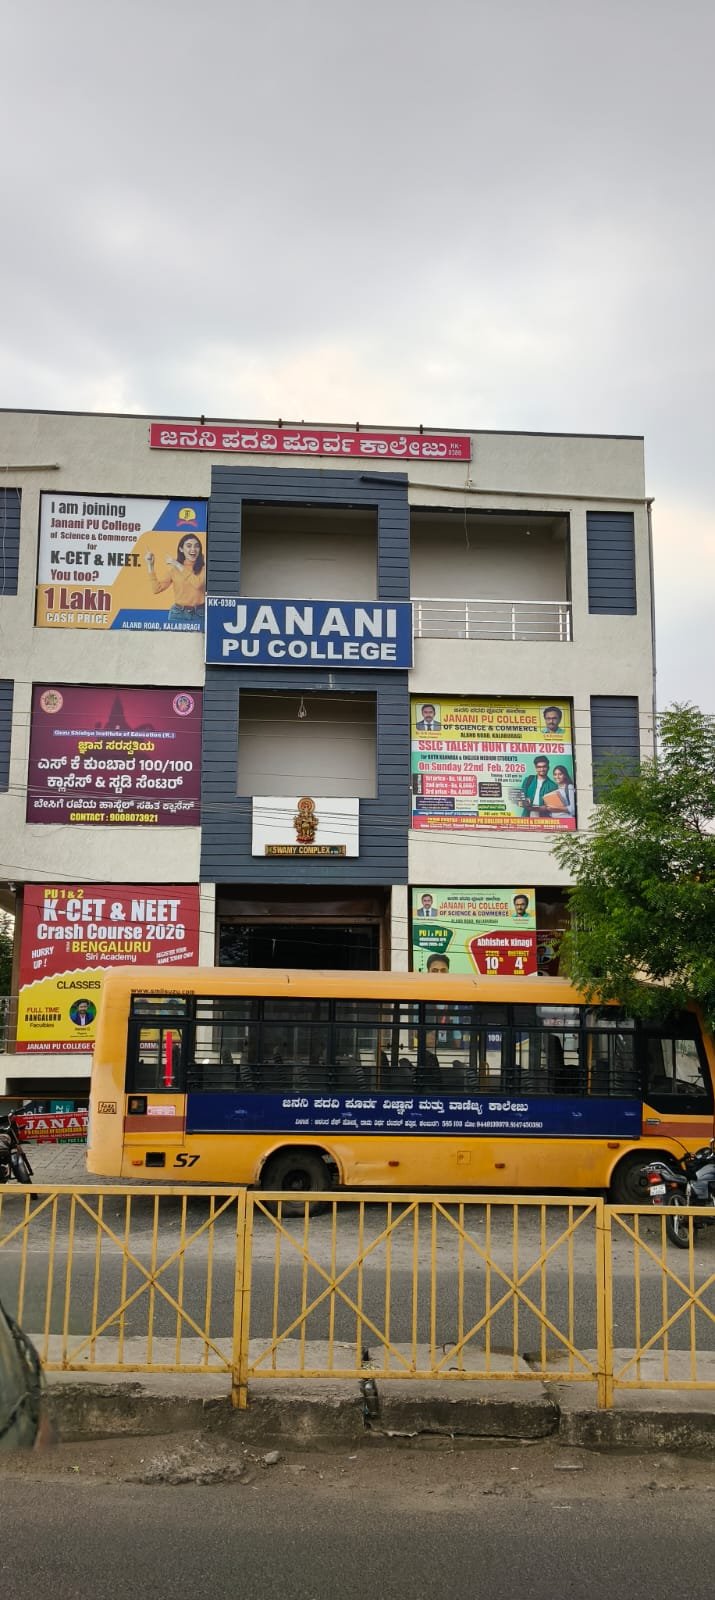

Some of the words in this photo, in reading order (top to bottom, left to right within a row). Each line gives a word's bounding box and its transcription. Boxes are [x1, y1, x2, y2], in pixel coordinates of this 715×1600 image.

[160, 428, 216, 447] ಜನನಿ
[222, 430, 277, 449] ಪದವಿ
[283, 432, 354, 452] ಪೂರ್ವ
[360, 436, 447, 456] ಕಾಲೇಜು
[51, 502, 55, 513] I
[58, 502, 78, 514] am
[82, 502, 126, 517] joining
[50, 518, 84, 529] Janani
[86, 520, 99, 530] PU
[102, 520, 141, 532] College
[60, 532, 90, 540] Science
[98, 533, 138, 542] Commerce
[51, 550, 91, 565] K-CET
[94, 554, 104, 566] &
[108, 553, 141, 567] NEET.
[51, 569, 71, 580] You
[74, 570, 99, 581] too?
[44, 588, 54, 608] 1
[60, 588, 111, 611] Lakh
[47, 612, 74, 623] CASH
[78, 613, 108, 624] PRICE
[223, 605, 396, 638] JANANI
[143, 622, 162, 630] ROAD,
[163, 623, 200, 631] KALABURAGI
[222, 639, 260, 657] PU
[267, 640, 396, 661] COLLEGE
[444, 715, 478, 723] JANANI
[497, 716, 537, 724] COLLEGE
[78, 740, 103, 754] ಜ್ಞಾನ
[106, 740, 155, 754] ಸರಸ್ವತಿಯ
[419, 740, 443, 751] SSLC
[446, 741, 479, 752] TALENT
[483, 742, 508, 752] HUNT
[510, 742, 536, 753] EXAM
[539, 743, 565, 753] 2026
[38, 756, 67, 770] ಎಸ್
[71, 756, 80, 770] ಕೆ
[84, 757, 136, 771] ಕುಂಬಾರ
[139, 760, 192, 772] 100/100
[419, 762, 429, 771] On
[432, 762, 462, 772] Sunday
[464, 763, 483, 771] 22nd
[488, 764, 503, 772] Feb.
[505, 764, 525, 772] 2026
[47, 773, 92, 792] ಕ್ಲಾಸೆಸ್
[95, 776, 105, 788] &
[109, 775, 132, 793] ಸ್ಟಡಿ
[136, 775, 183, 789] ಸೆಂಟರ್
[34, 798, 64, 808] ಬೇಸಿಗೆ
[70, 813, 104, 822] CONTACT
[110, 814, 158, 822] 9008073921
[272, 846, 296, 854] SWAMY
[299, 846, 330, 854] COMPLEX
[44, 889, 57, 898] PU
[61, 890, 65, 898] 1
[68, 890, 75, 898] &
[77, 890, 84, 898] 2
[43, 899, 106, 922] K-CET
[110, 902, 126, 922] &
[131, 900, 180, 922] NEET
[440, 902, 465, 910] JANANI
[467, 902, 477, 910] PU
[478, 902, 508, 910] COLLEGE
[37, 923, 83, 940] Crash
[87, 924, 142, 940] Course
[145, 924, 185, 940] 2026
[72, 941, 151, 953] BENGALURU
[477, 938, 509, 947] Abhishek
[511, 939, 532, 947] Kinagi
[31, 946, 54, 958] HURRY
[86, 953, 99, 961] Siri
[100, 953, 136, 962] Academy
[33, 960, 42, 969] UP
[57, 981, 101, 990] CLASSES
[282, 1097, 309, 1108] ಜನನಿ
[314, 1098, 340, 1108] ಪದವಿ
[345, 1098, 377, 1109] ಪೂರ್ವ
[383, 1099, 413, 1115] ವಿಜ್ಞಾನ
[419, 1100, 445, 1113] ಮತ್ತು
[449, 1100, 483, 1115] ವಾಣಿಜ್ಯ
[488, 1100, 528, 1112] ಕಾಲೇಜು
[173, 1154, 200, 1168] S7
